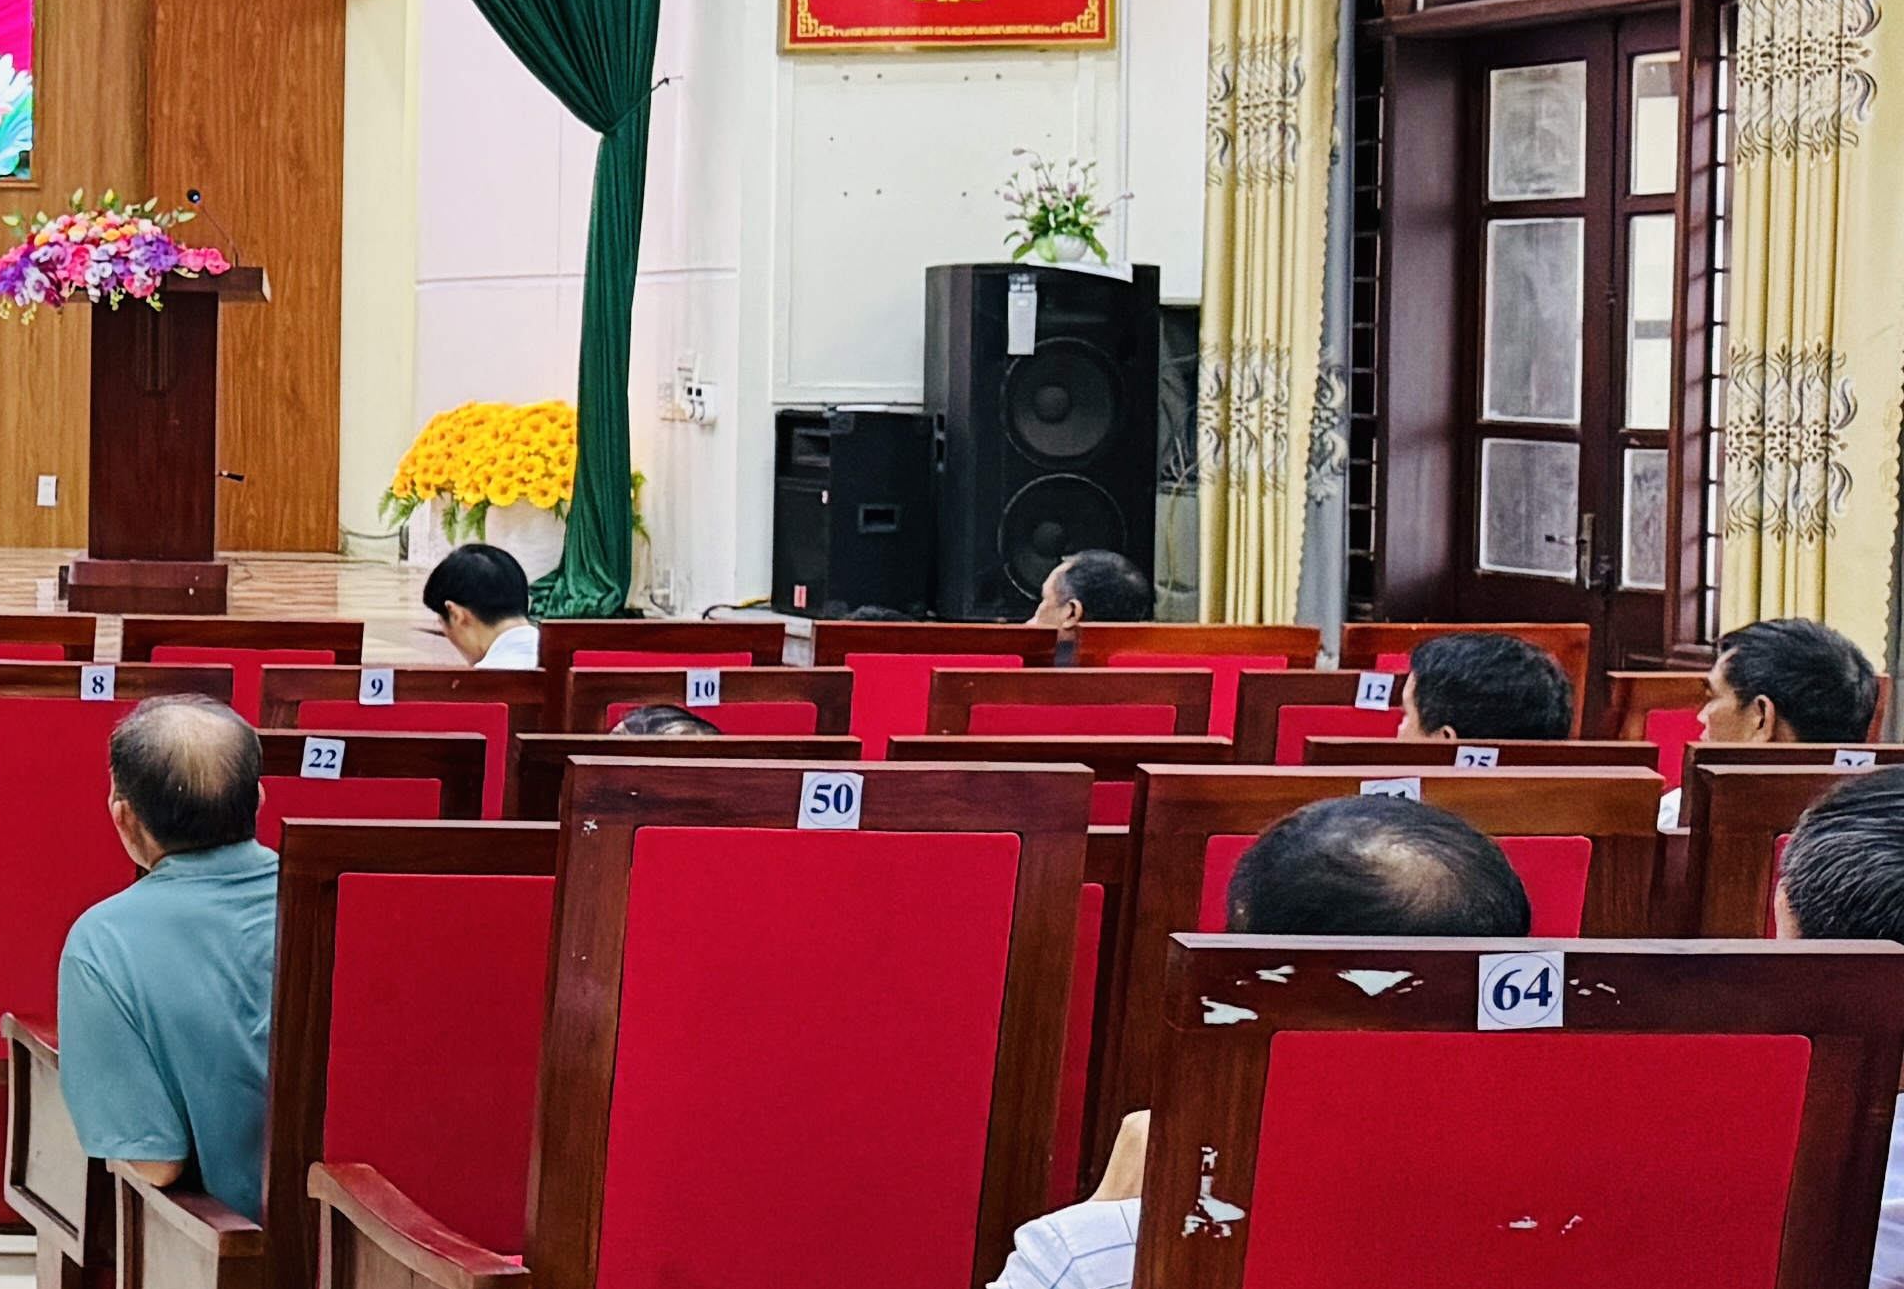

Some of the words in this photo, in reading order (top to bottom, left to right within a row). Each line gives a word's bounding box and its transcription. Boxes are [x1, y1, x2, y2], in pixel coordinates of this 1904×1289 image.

[93, 676, 104, 693] 8
[371, 679, 383, 696] 9
[693, 681, 715, 698] 10
[1364, 683, 1386, 700] 12
[309, 748, 336, 768] 22
[811, 784, 853, 813] 50
[1493, 967, 1552, 1010] 64
